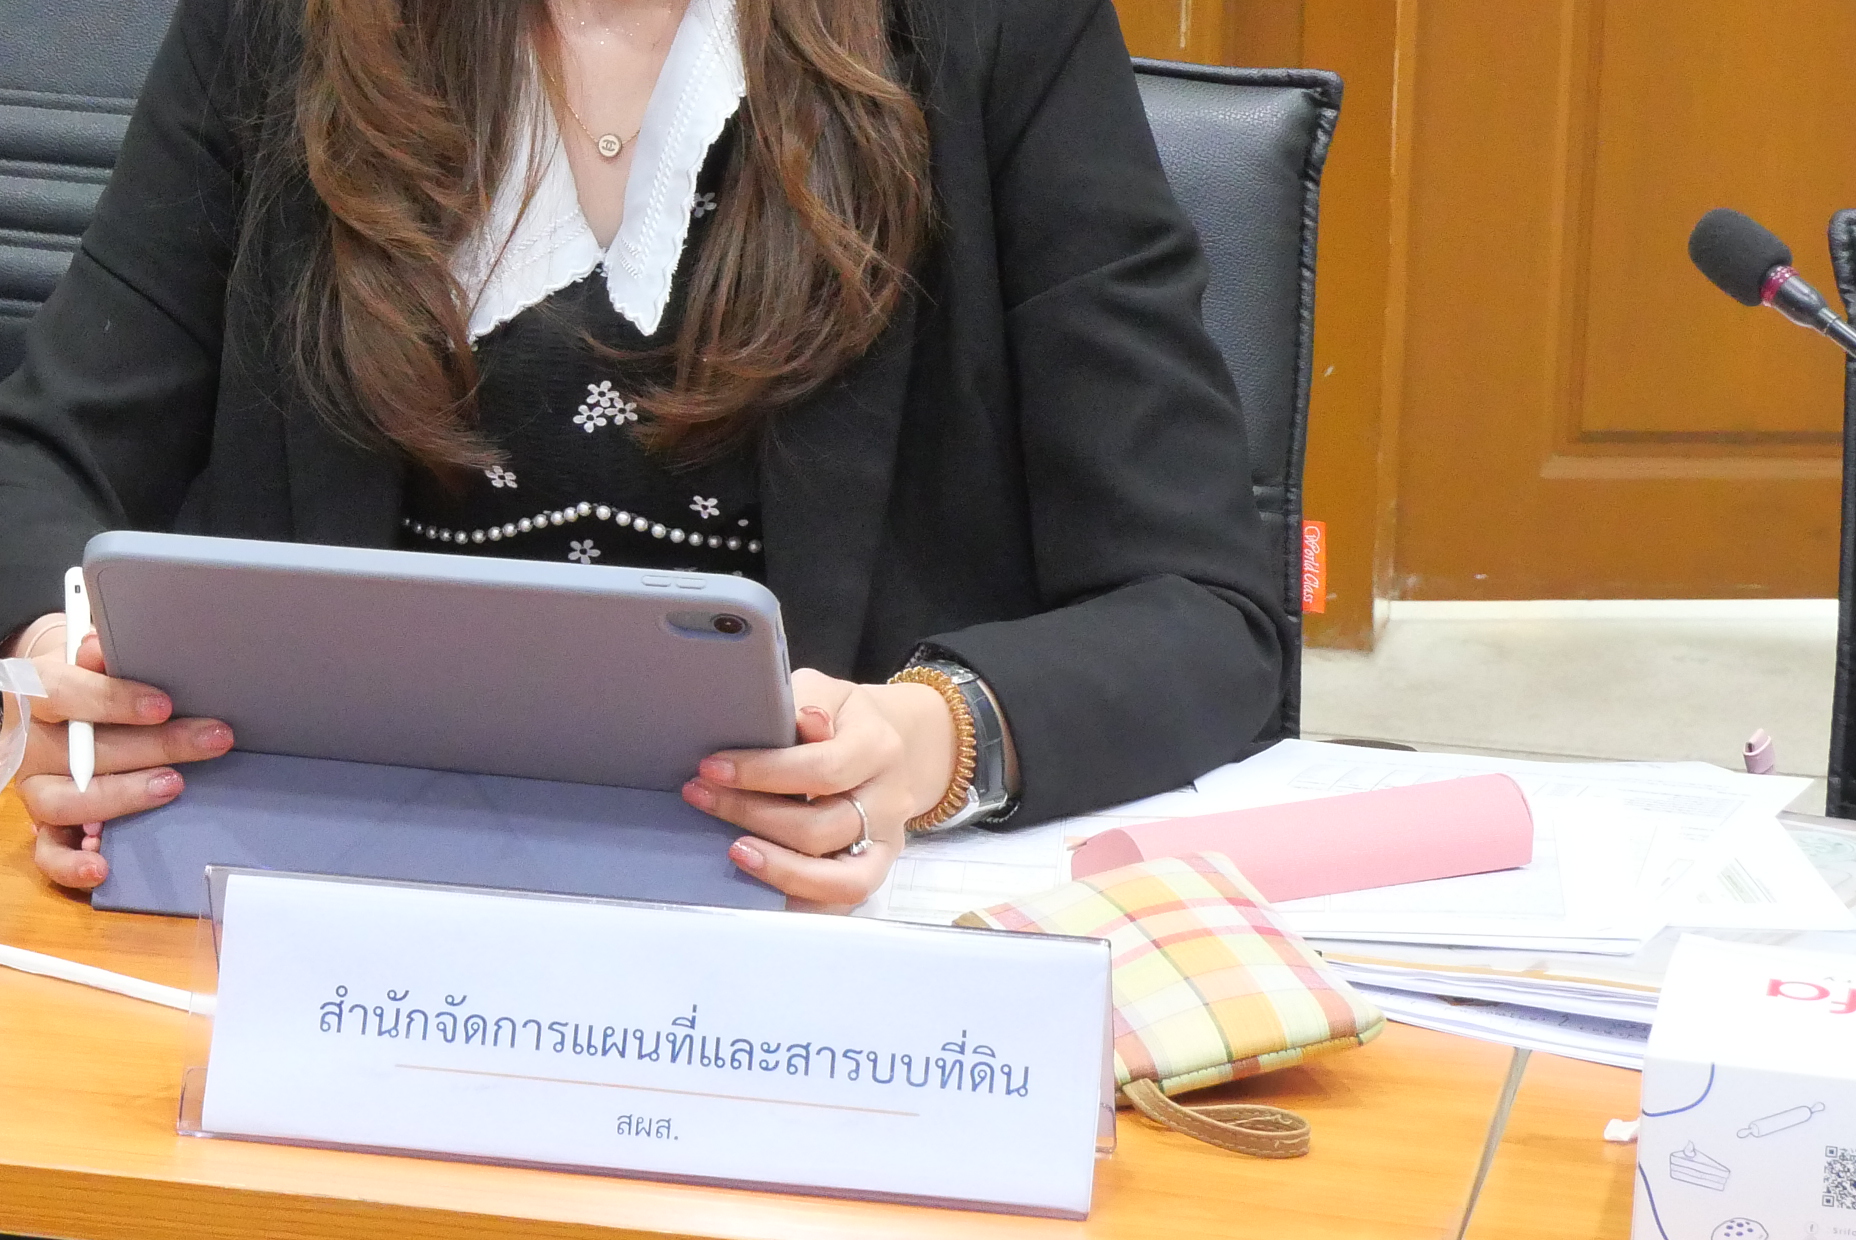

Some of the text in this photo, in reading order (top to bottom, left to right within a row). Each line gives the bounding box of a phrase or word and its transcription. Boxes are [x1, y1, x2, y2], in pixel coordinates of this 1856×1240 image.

[1303, 525, 1321, 604] World Class
[318, 984, 1031, 1098] สำนักจัดการแผนที่และสารบบที่ดิน
[616, 1113, 679, 1141] สผส.
